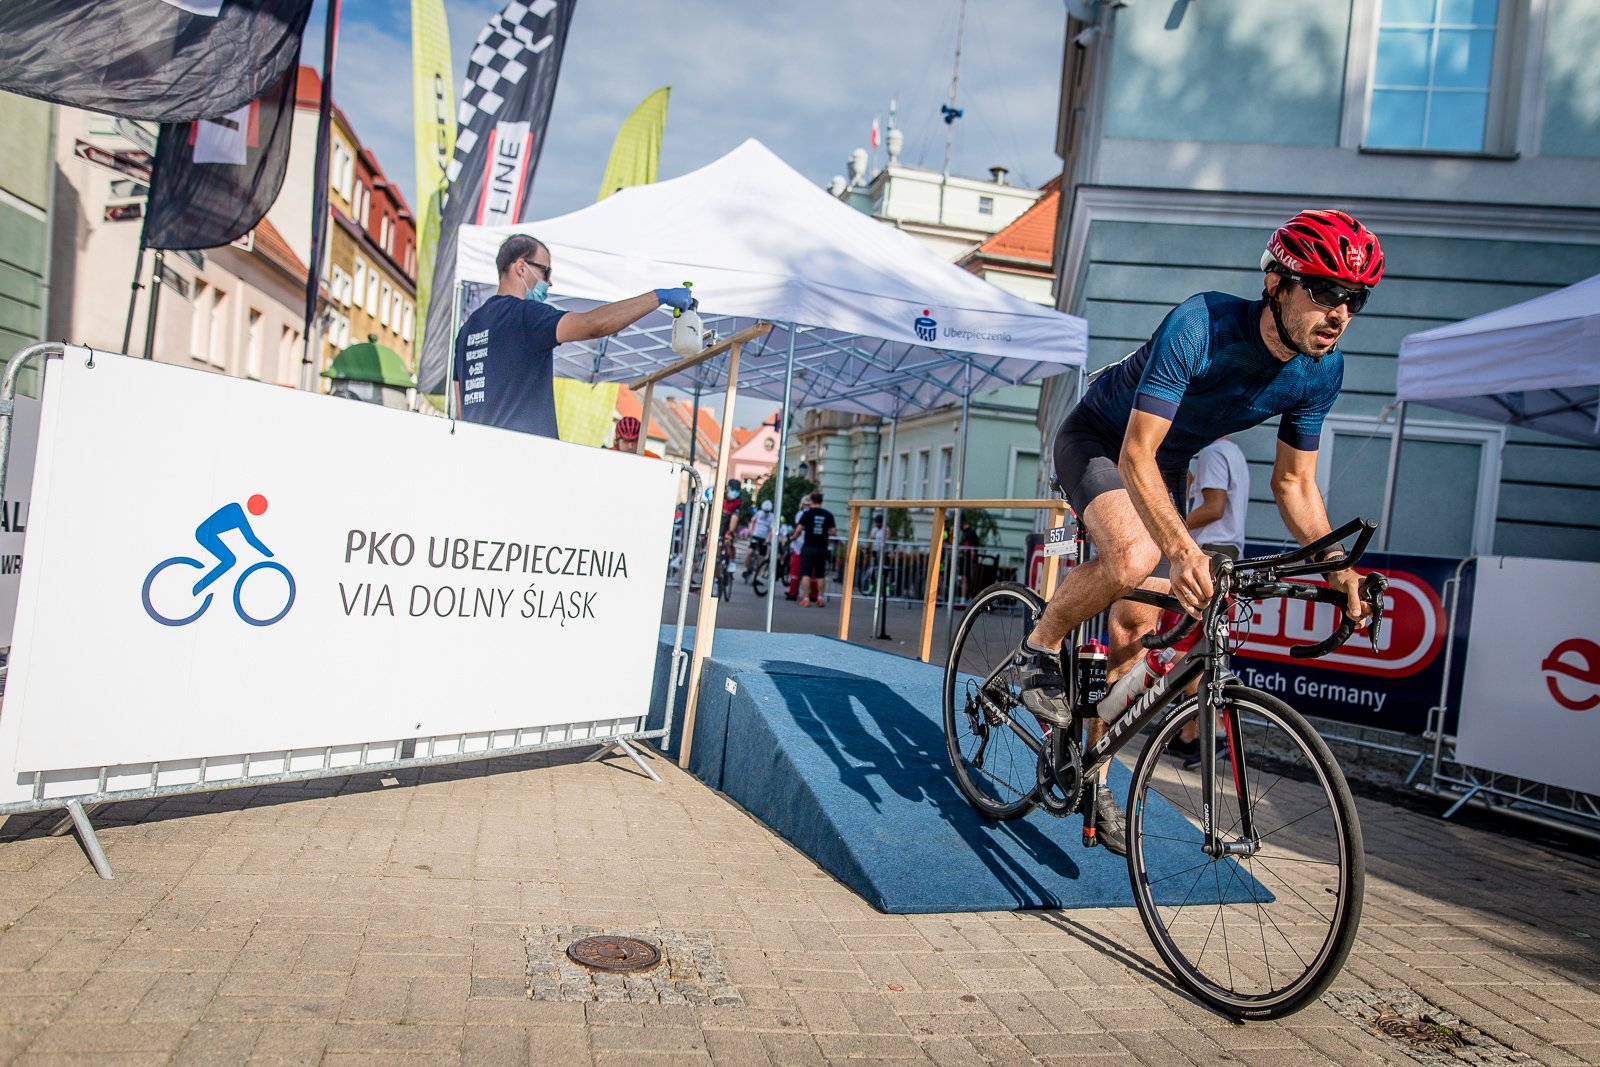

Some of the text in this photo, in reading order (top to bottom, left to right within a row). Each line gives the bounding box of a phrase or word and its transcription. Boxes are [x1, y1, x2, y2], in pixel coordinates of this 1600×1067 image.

[490, 139, 520, 214] LINE
[345, 529, 628, 578] PKO UBEZPIECZENIA
[1050, 528, 1066, 542] 557
[338, 582, 598, 627] VIA DOLNY ŚLĄSK
[1246, 668, 1286, 692] Tech
[1294, 676, 1387, 712] Germany
